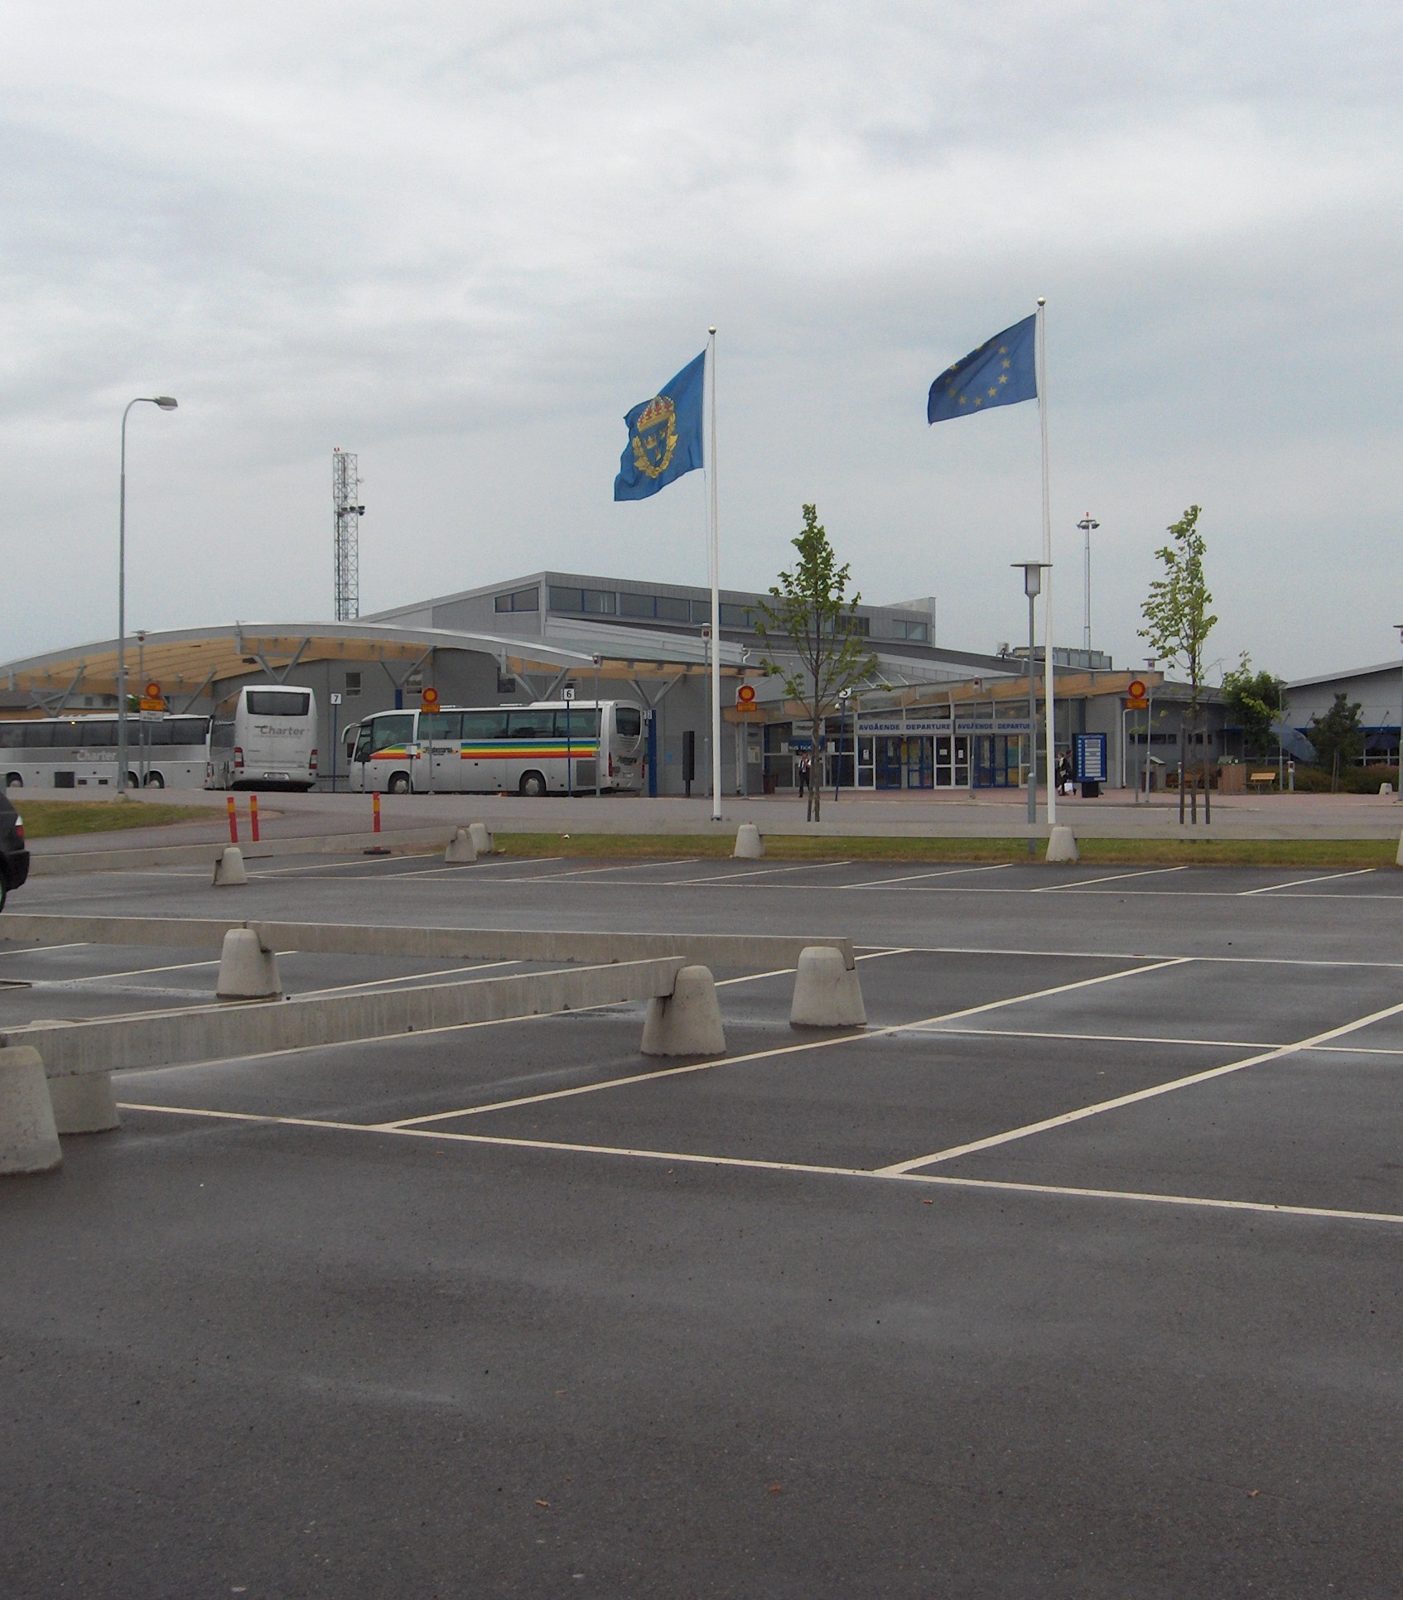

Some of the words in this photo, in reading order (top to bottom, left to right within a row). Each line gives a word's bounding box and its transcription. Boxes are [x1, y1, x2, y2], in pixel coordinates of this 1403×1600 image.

[566, 689, 572, 699] 6
[333, 695, 339, 703] 7
[254, 725, 305, 737] Charter
[906, 722, 951, 731] DEPARTURE
